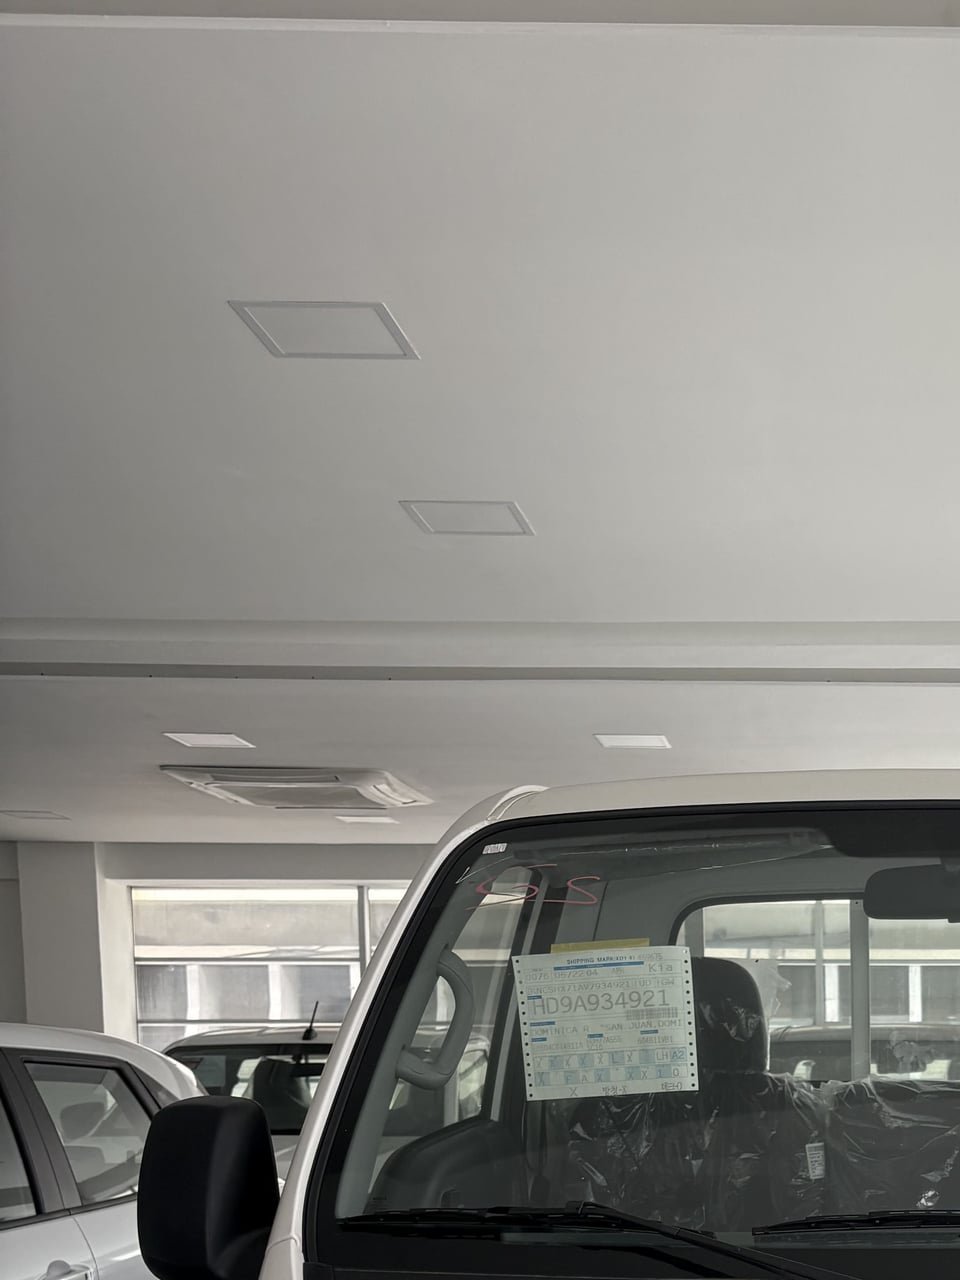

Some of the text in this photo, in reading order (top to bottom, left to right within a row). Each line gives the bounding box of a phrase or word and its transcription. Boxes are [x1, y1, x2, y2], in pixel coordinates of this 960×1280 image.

[647, 962, 672, 972] Kia
[531, 988, 670, 1015] HD9A934921
[670, 1049, 685, 1059] A2
